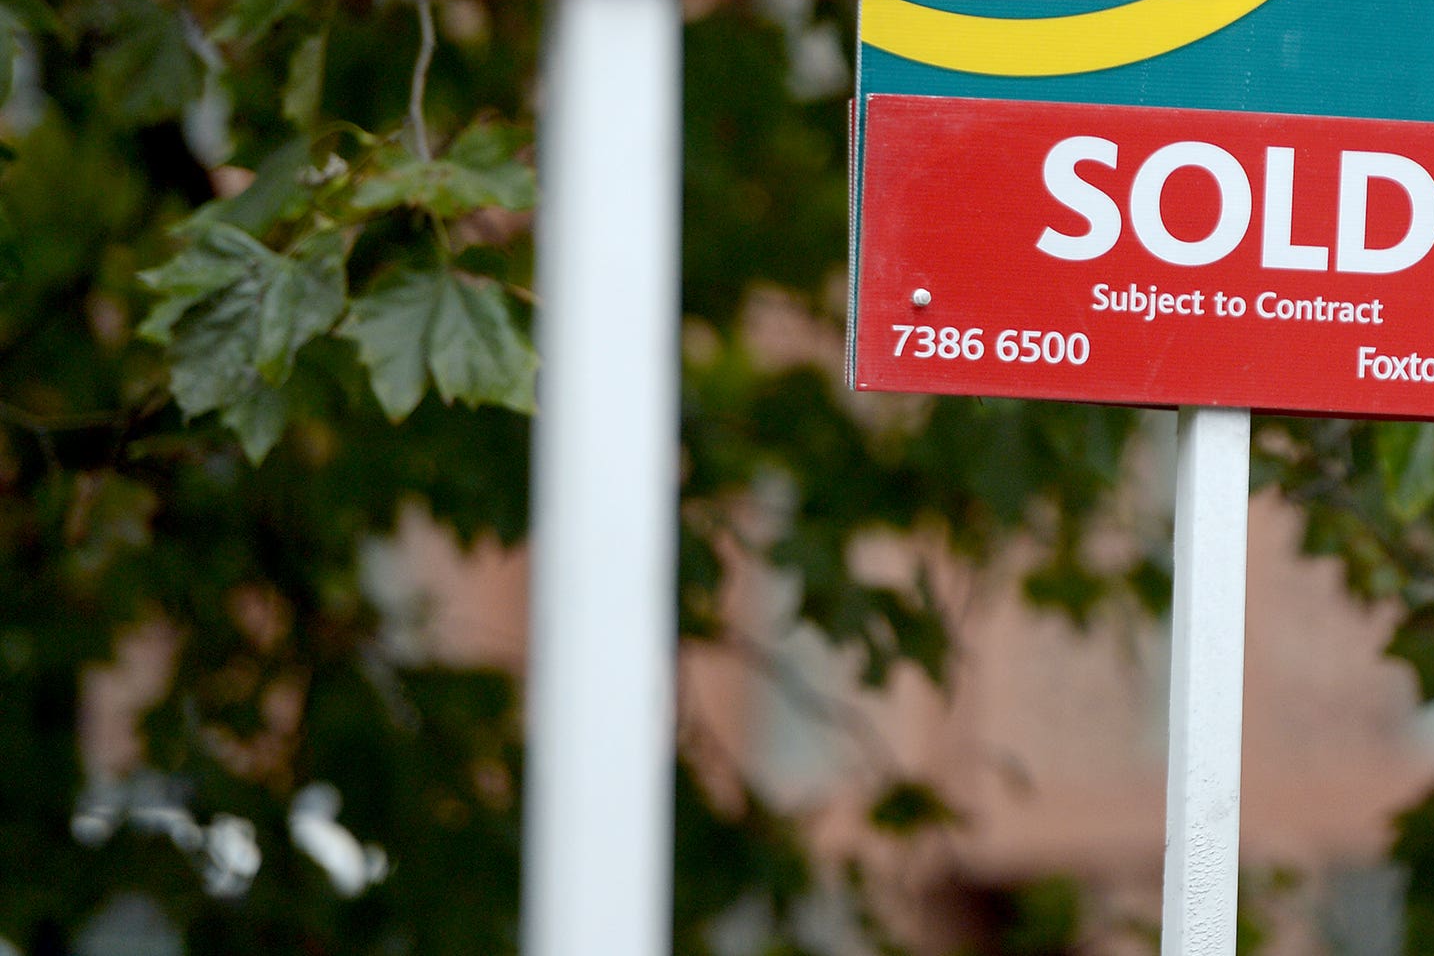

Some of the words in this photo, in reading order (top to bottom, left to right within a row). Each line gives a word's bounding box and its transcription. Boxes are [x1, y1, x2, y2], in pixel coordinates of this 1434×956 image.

[1092, 284, 1204, 322] Subject
[1214, 292, 1246, 317] to
[1256, 292, 1383, 324] Contract
[892, 325, 984, 360] 7386
[996, 330, 1090, 365] 6500
